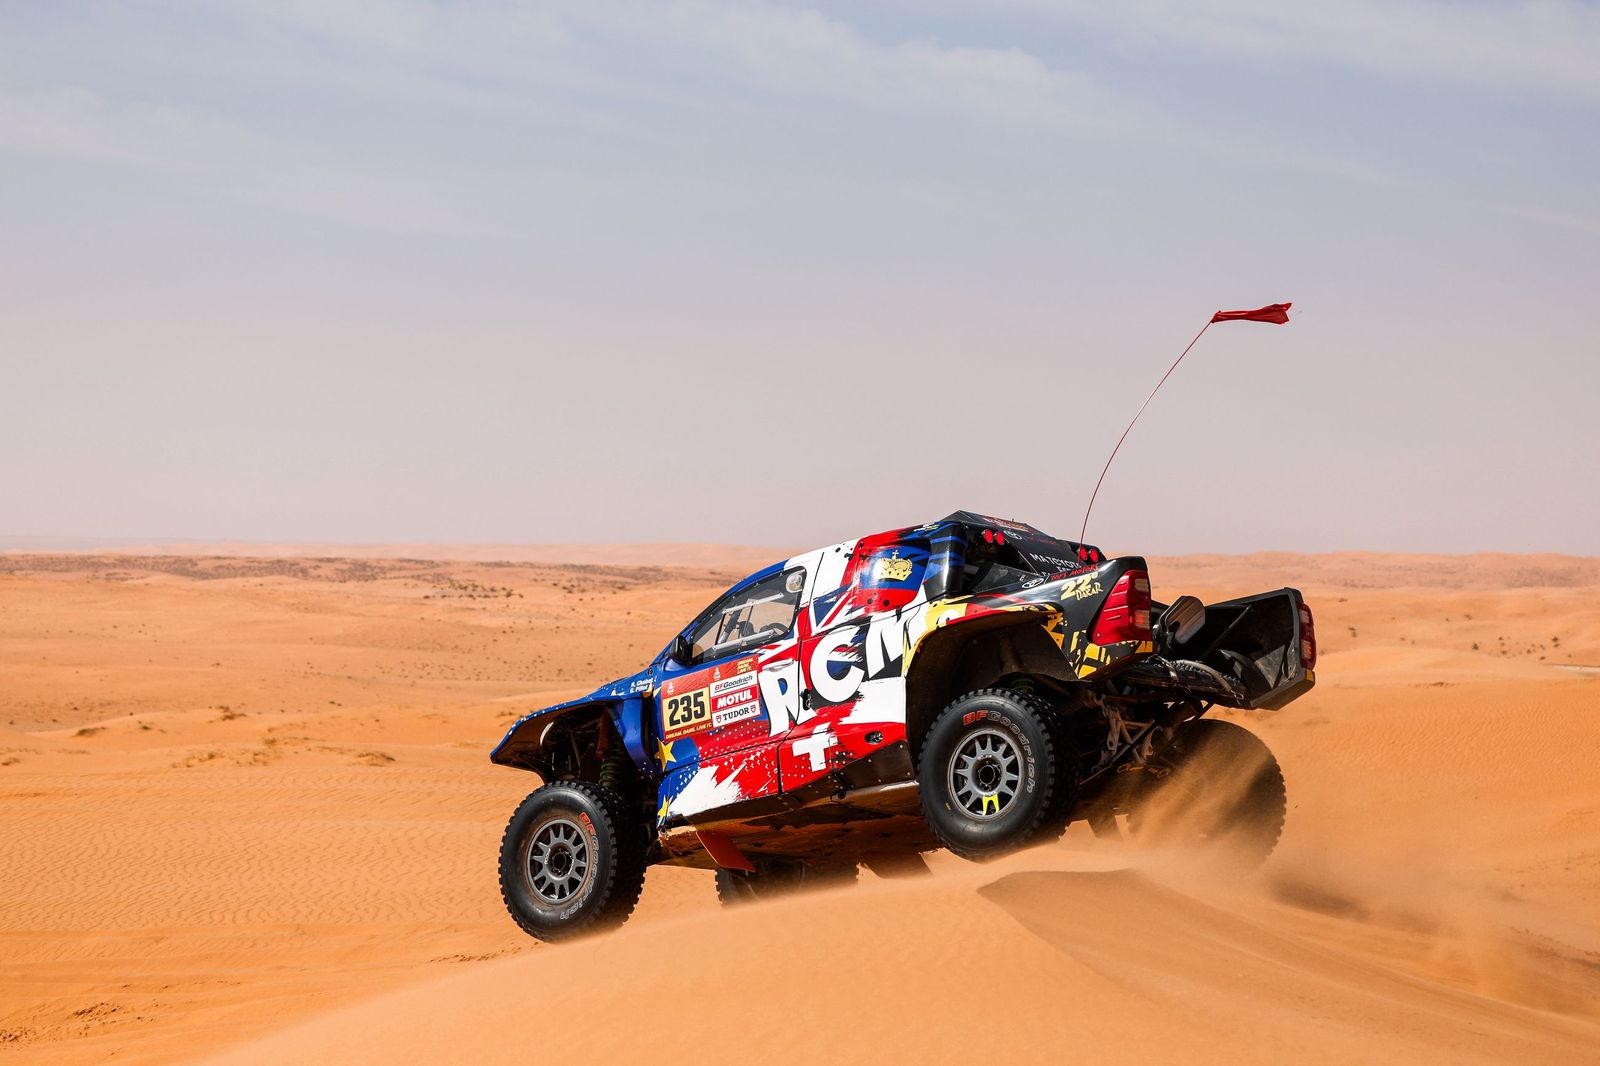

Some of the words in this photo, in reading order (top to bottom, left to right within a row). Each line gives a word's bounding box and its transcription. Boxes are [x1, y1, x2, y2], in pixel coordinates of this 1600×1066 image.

[1076, 582, 1104, 600] DAKAR
[714, 675, 753, 691] BFGoodrich
[717, 690, 753, 709] MOTUL
[668, 691, 706, 727] 235
[722, 706, 750, 721] TUDOR
[963, 710, 1035, 793] BFGoodrich
